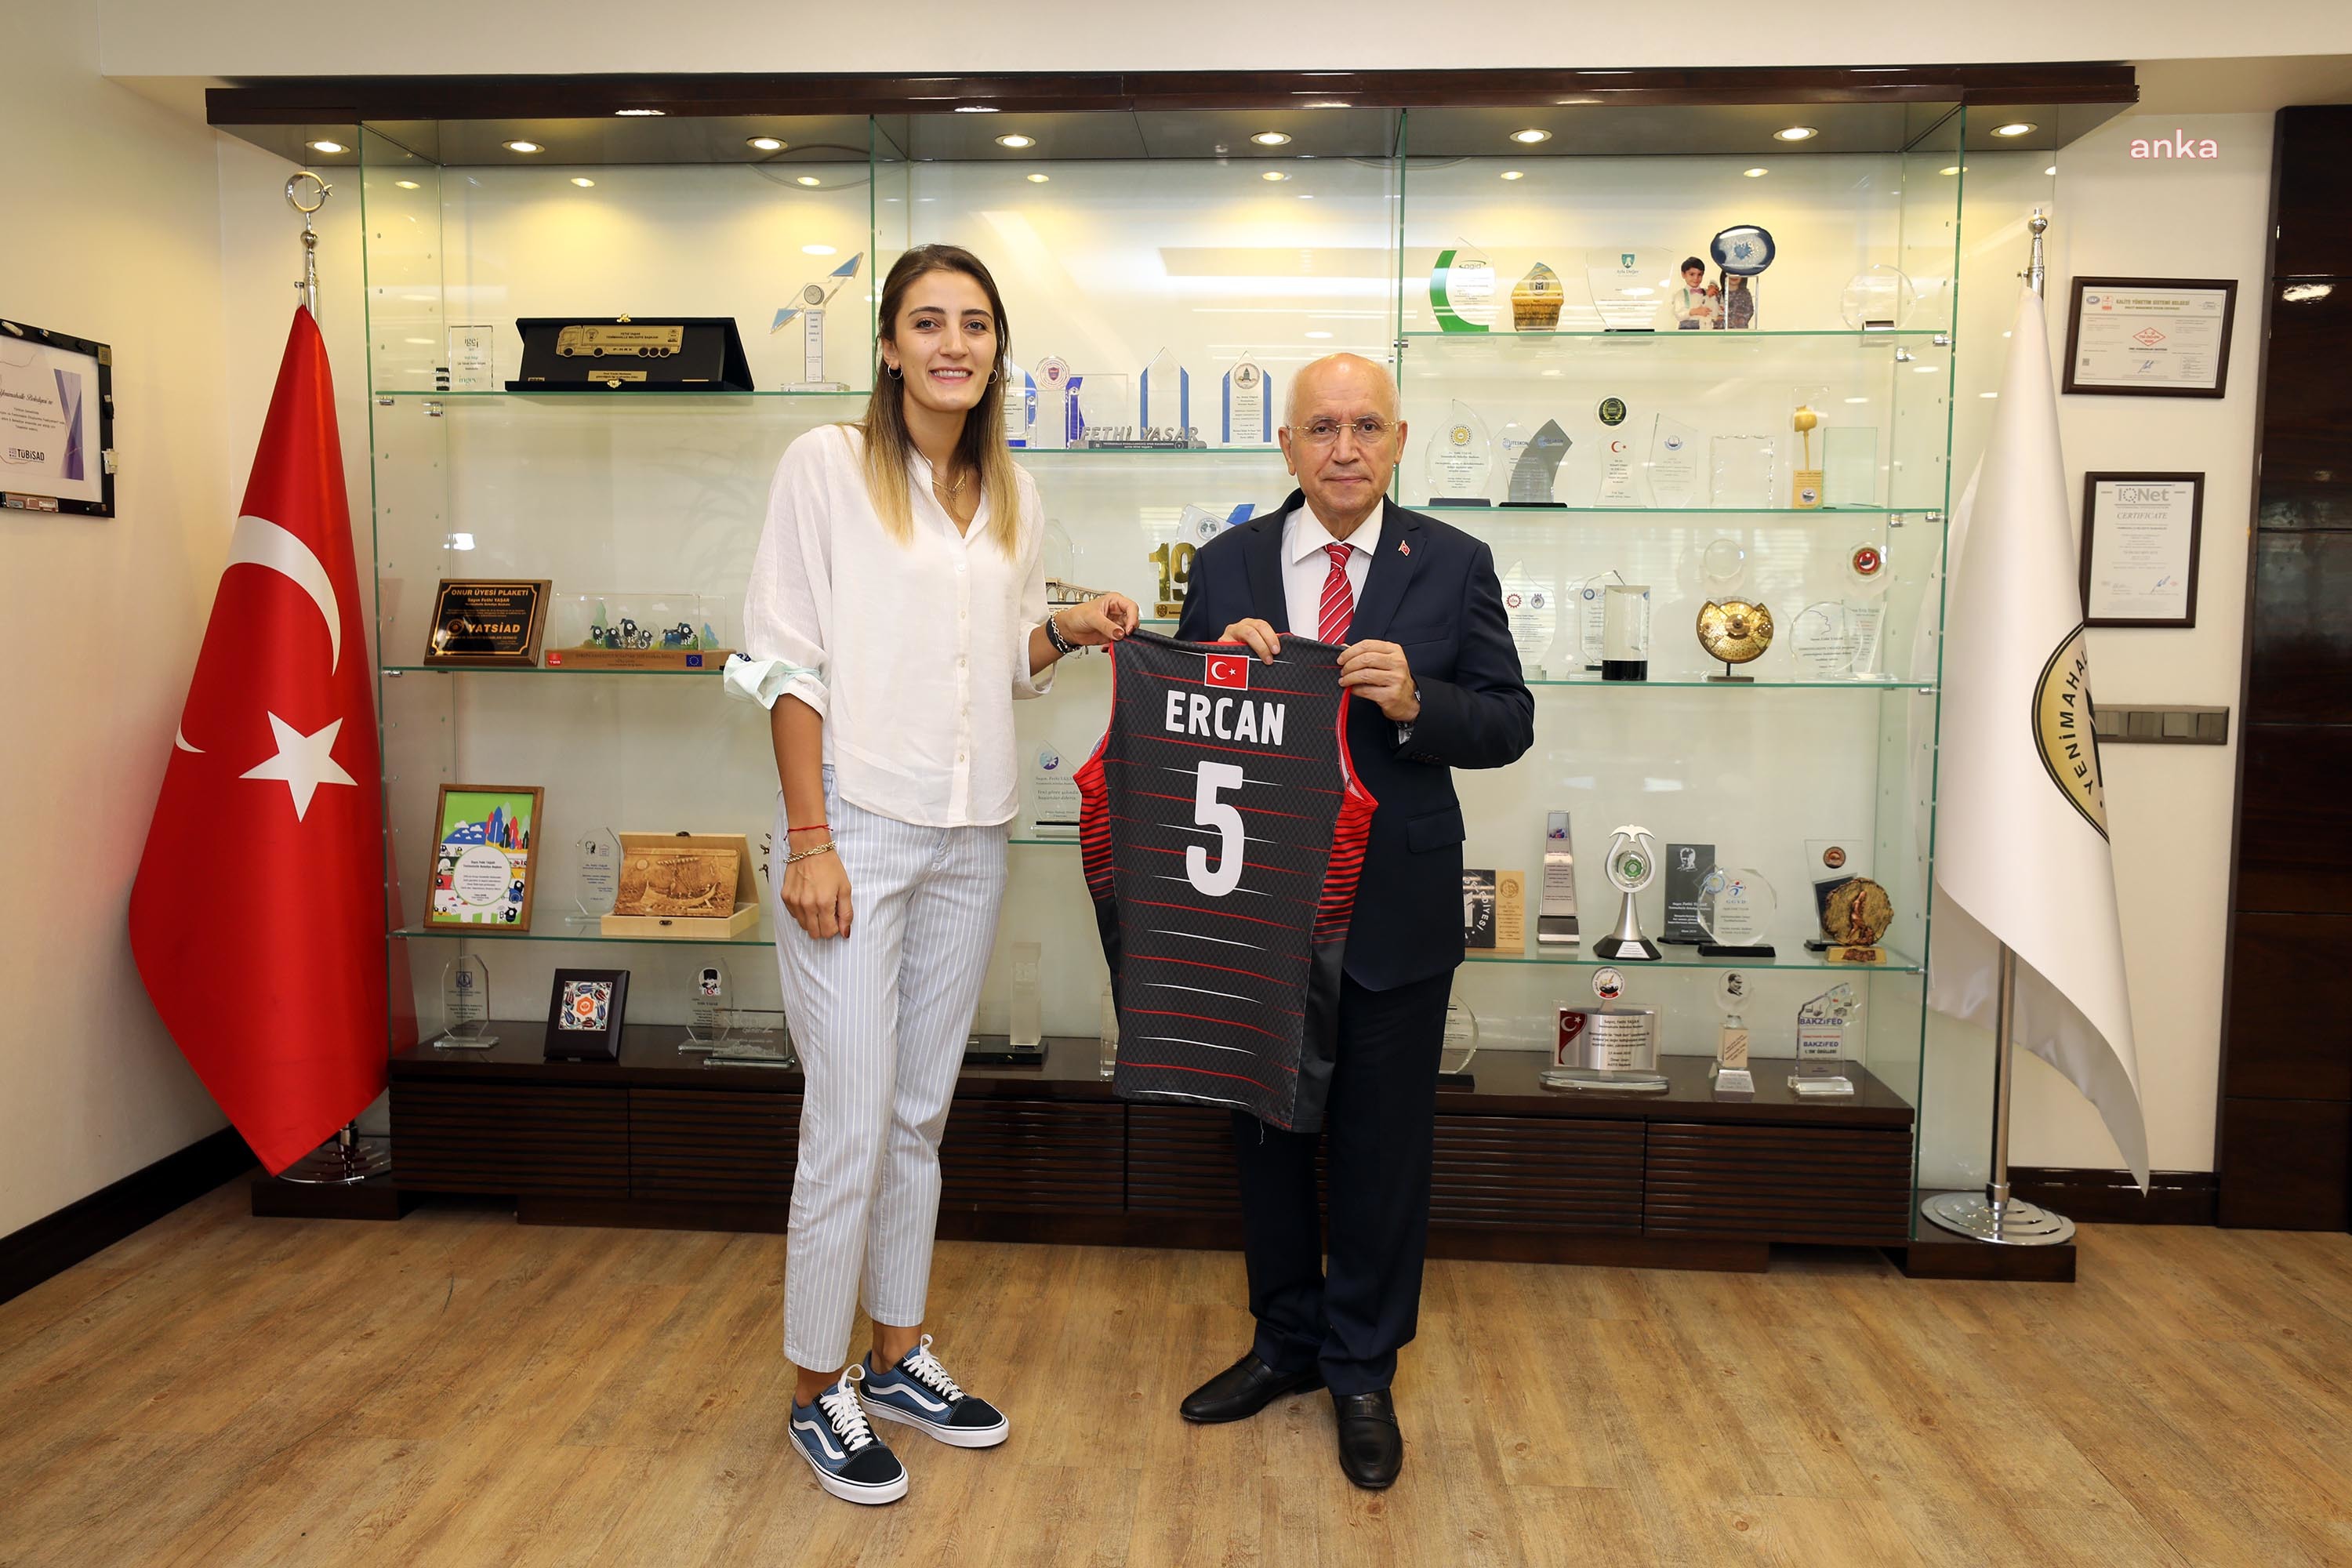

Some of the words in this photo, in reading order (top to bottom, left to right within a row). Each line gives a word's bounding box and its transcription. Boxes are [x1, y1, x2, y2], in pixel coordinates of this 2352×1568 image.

[2118, 487, 2169, 503] IQNet
[469, 622, 521, 633] YATSİAD
[1165, 690, 1285, 746] ERCAN
[1186, 760, 1244, 896] 5
